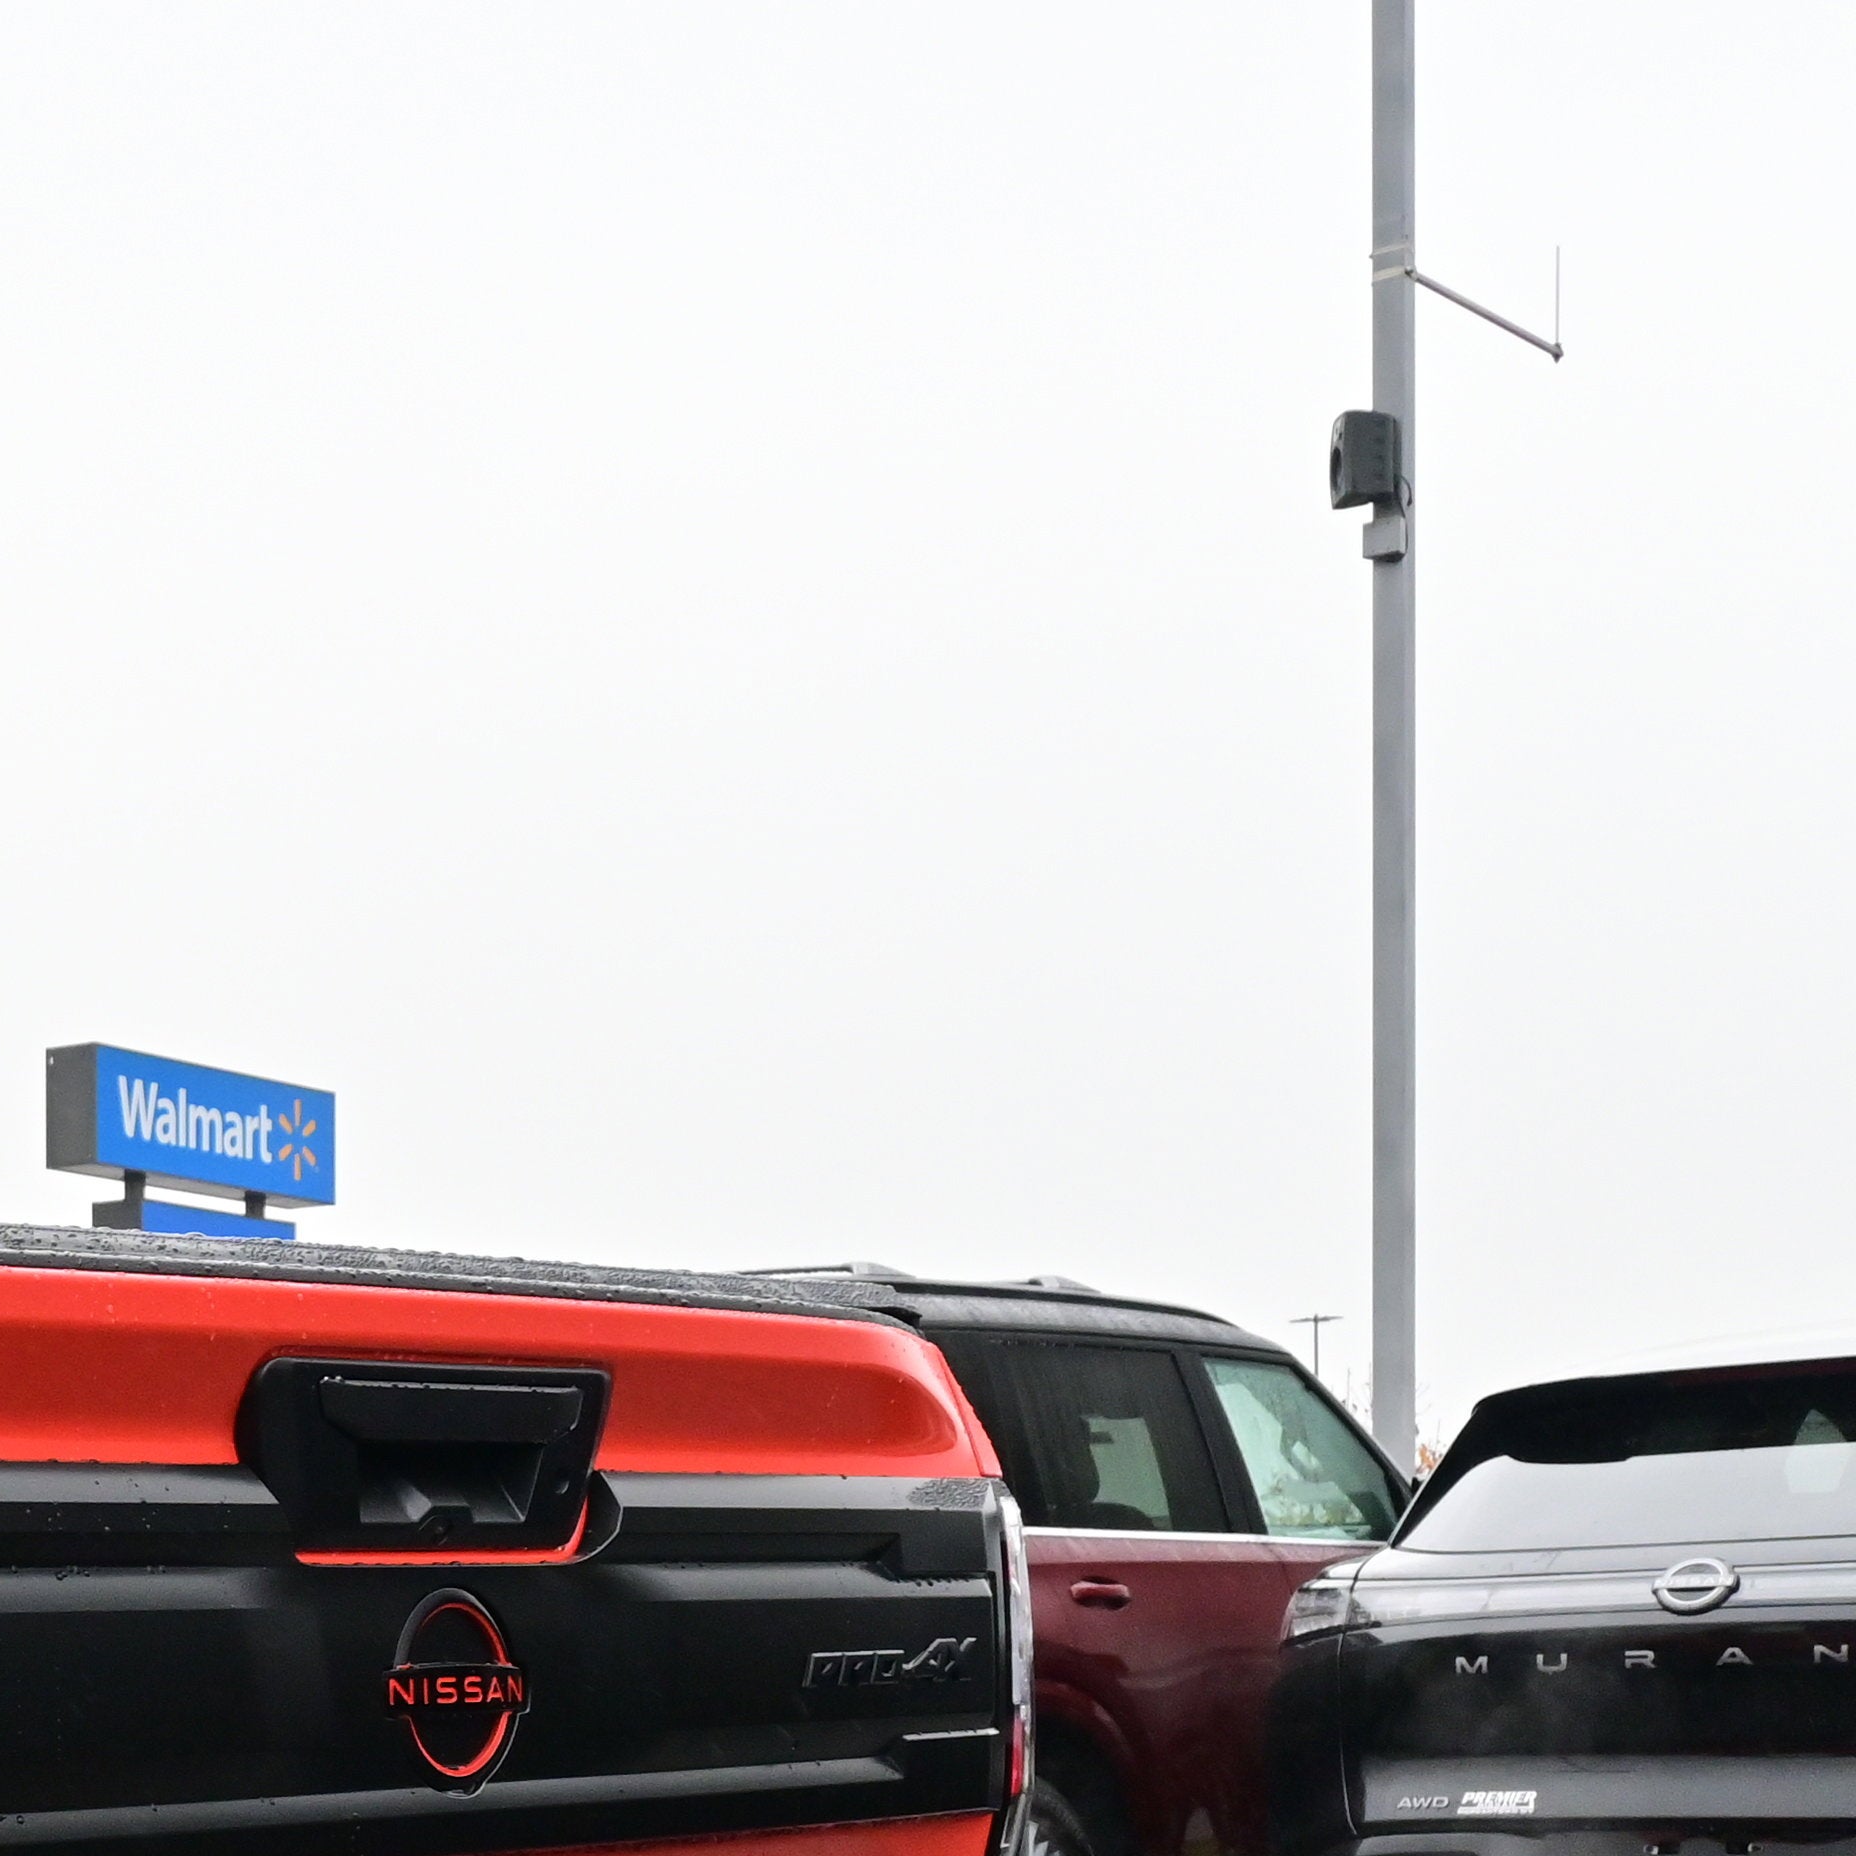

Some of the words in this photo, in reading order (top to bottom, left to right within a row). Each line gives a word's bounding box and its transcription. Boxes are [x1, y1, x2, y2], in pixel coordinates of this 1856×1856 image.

[117, 1074, 273, 1164] Walmart
[389, 1674, 523, 1706] NISSAN
[1397, 1796, 1450, 1809] AWD
[1461, 1791, 1537, 1806] PREMIER
